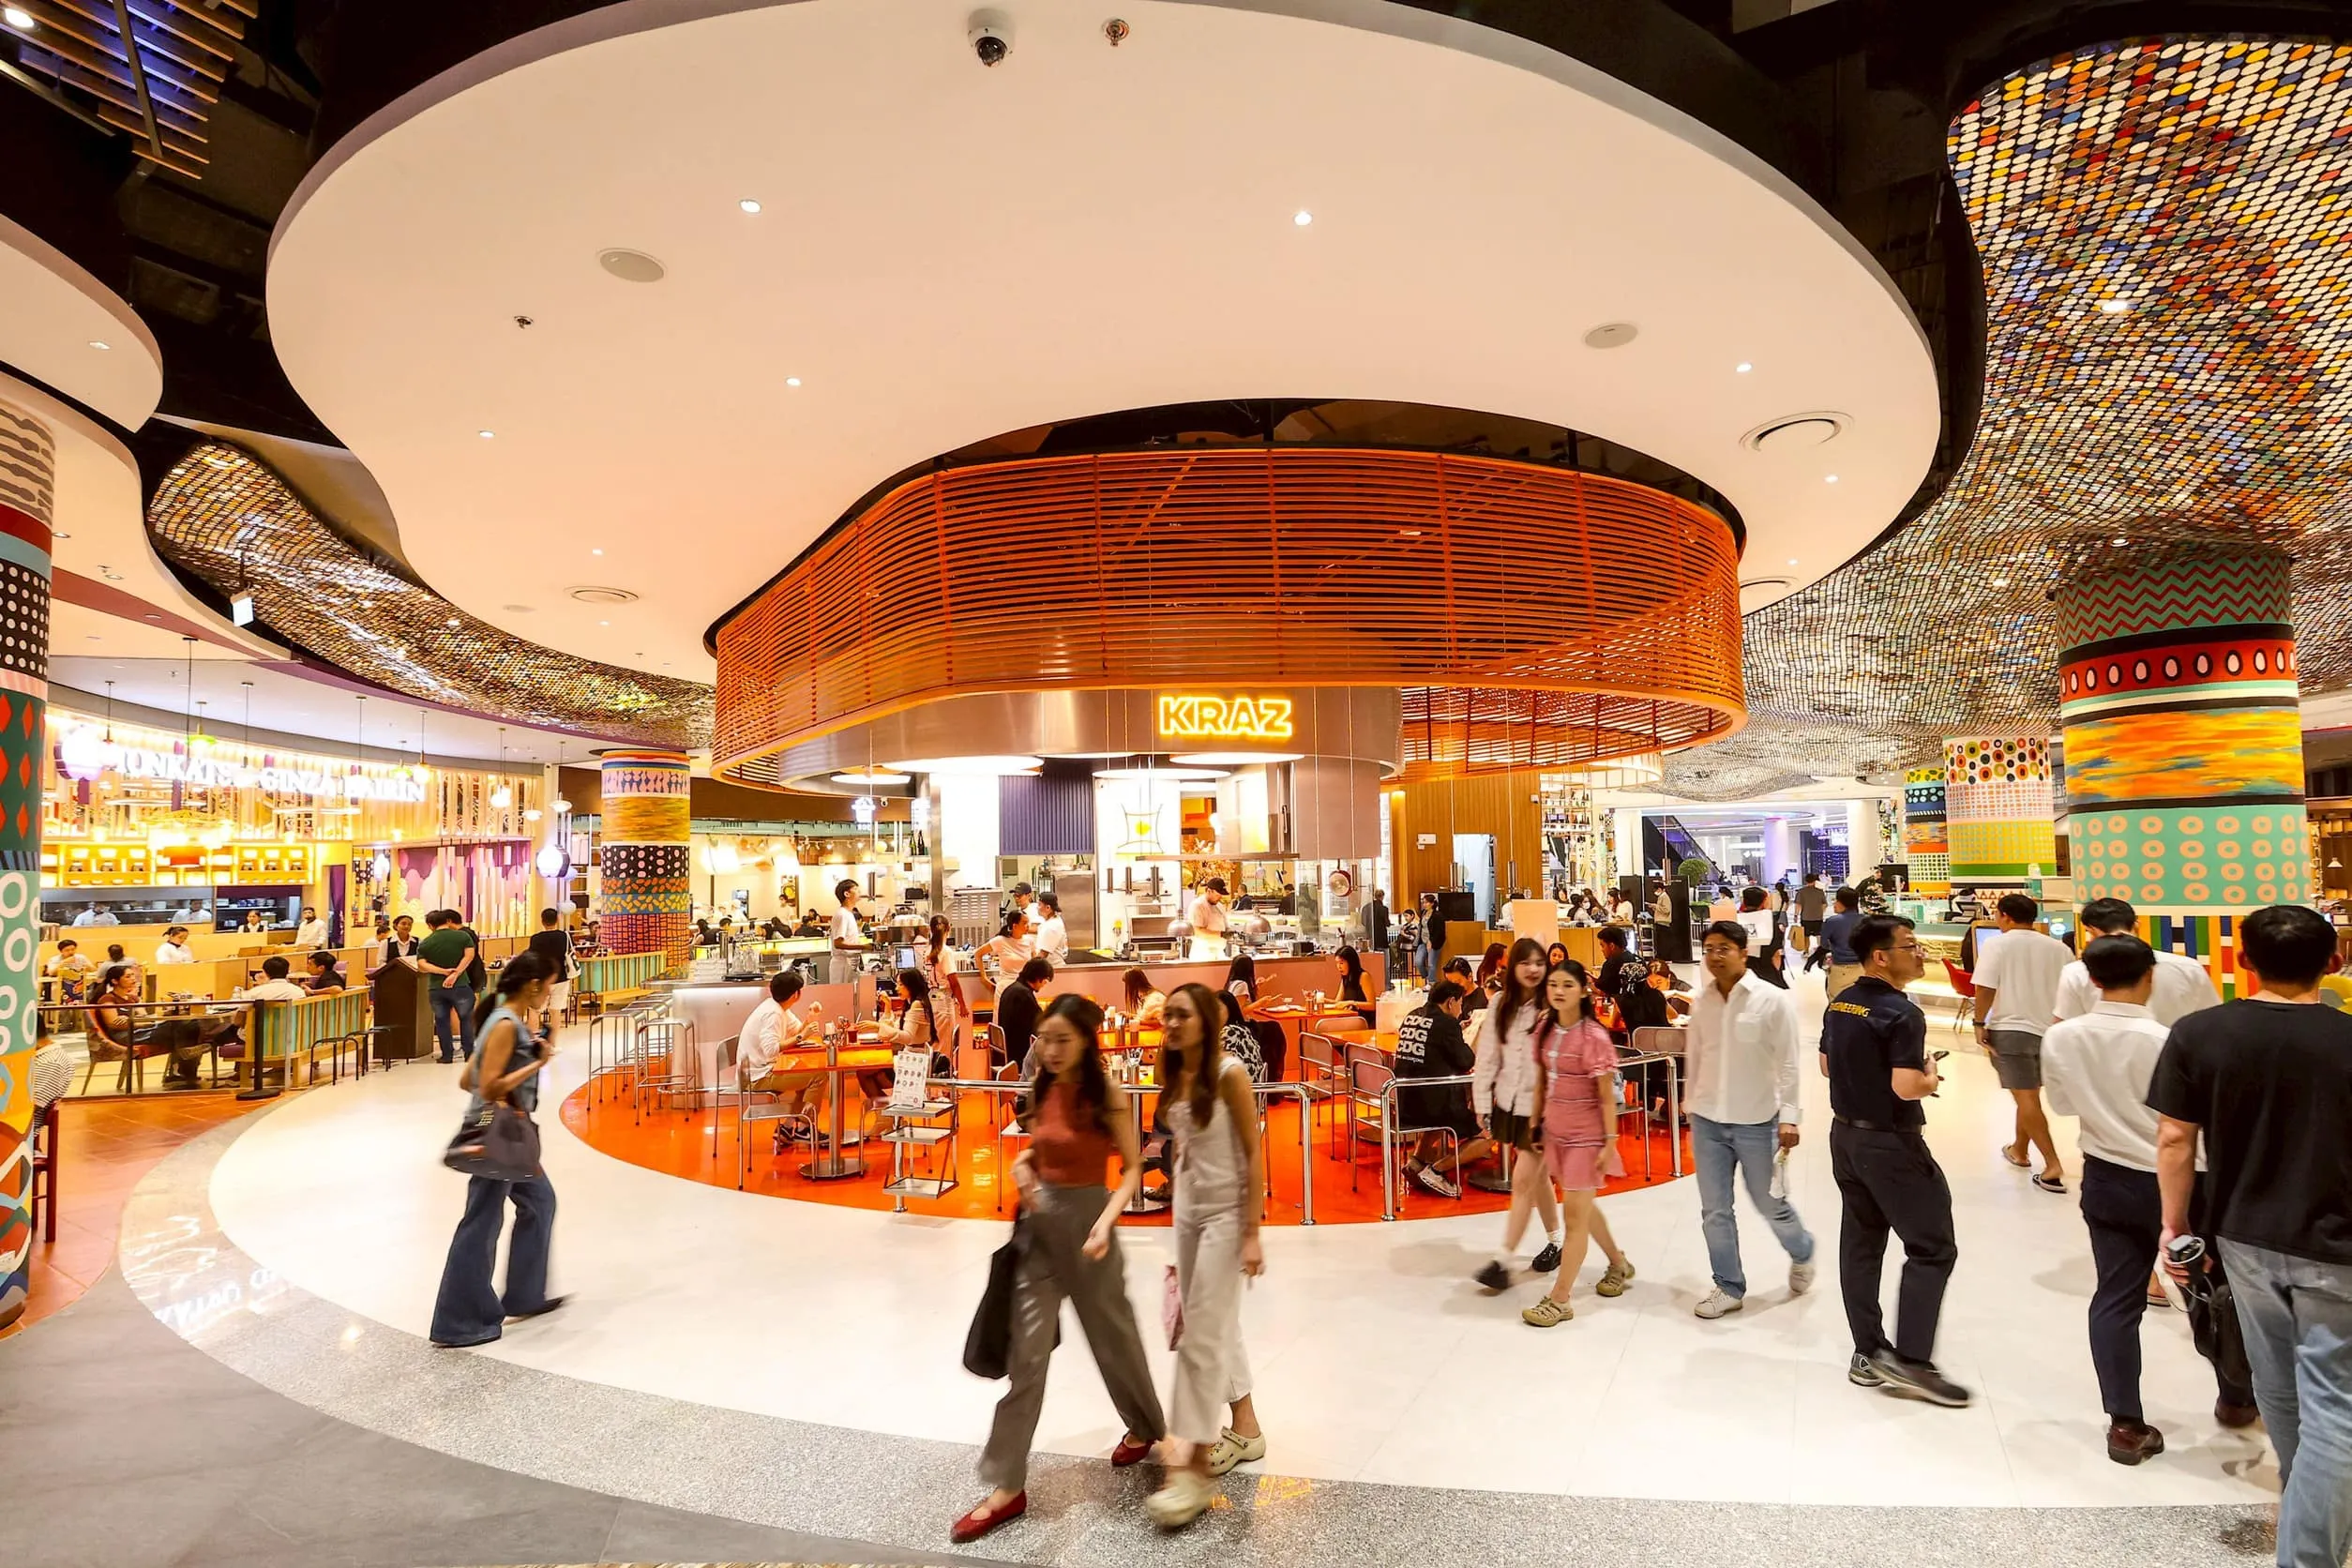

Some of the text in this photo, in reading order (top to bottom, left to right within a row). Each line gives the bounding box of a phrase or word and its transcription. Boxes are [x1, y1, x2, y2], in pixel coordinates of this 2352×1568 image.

[1159, 696, 1293, 737] KRAZ
[114, 746, 251, 790] ONKATS
[1829, 1002, 1872, 1018] NGINEERING
[1404, 1015, 1434, 1030] CDG
[1399, 1027, 1428, 1042] CDG
[1396, 1040, 1425, 1057] CDG
